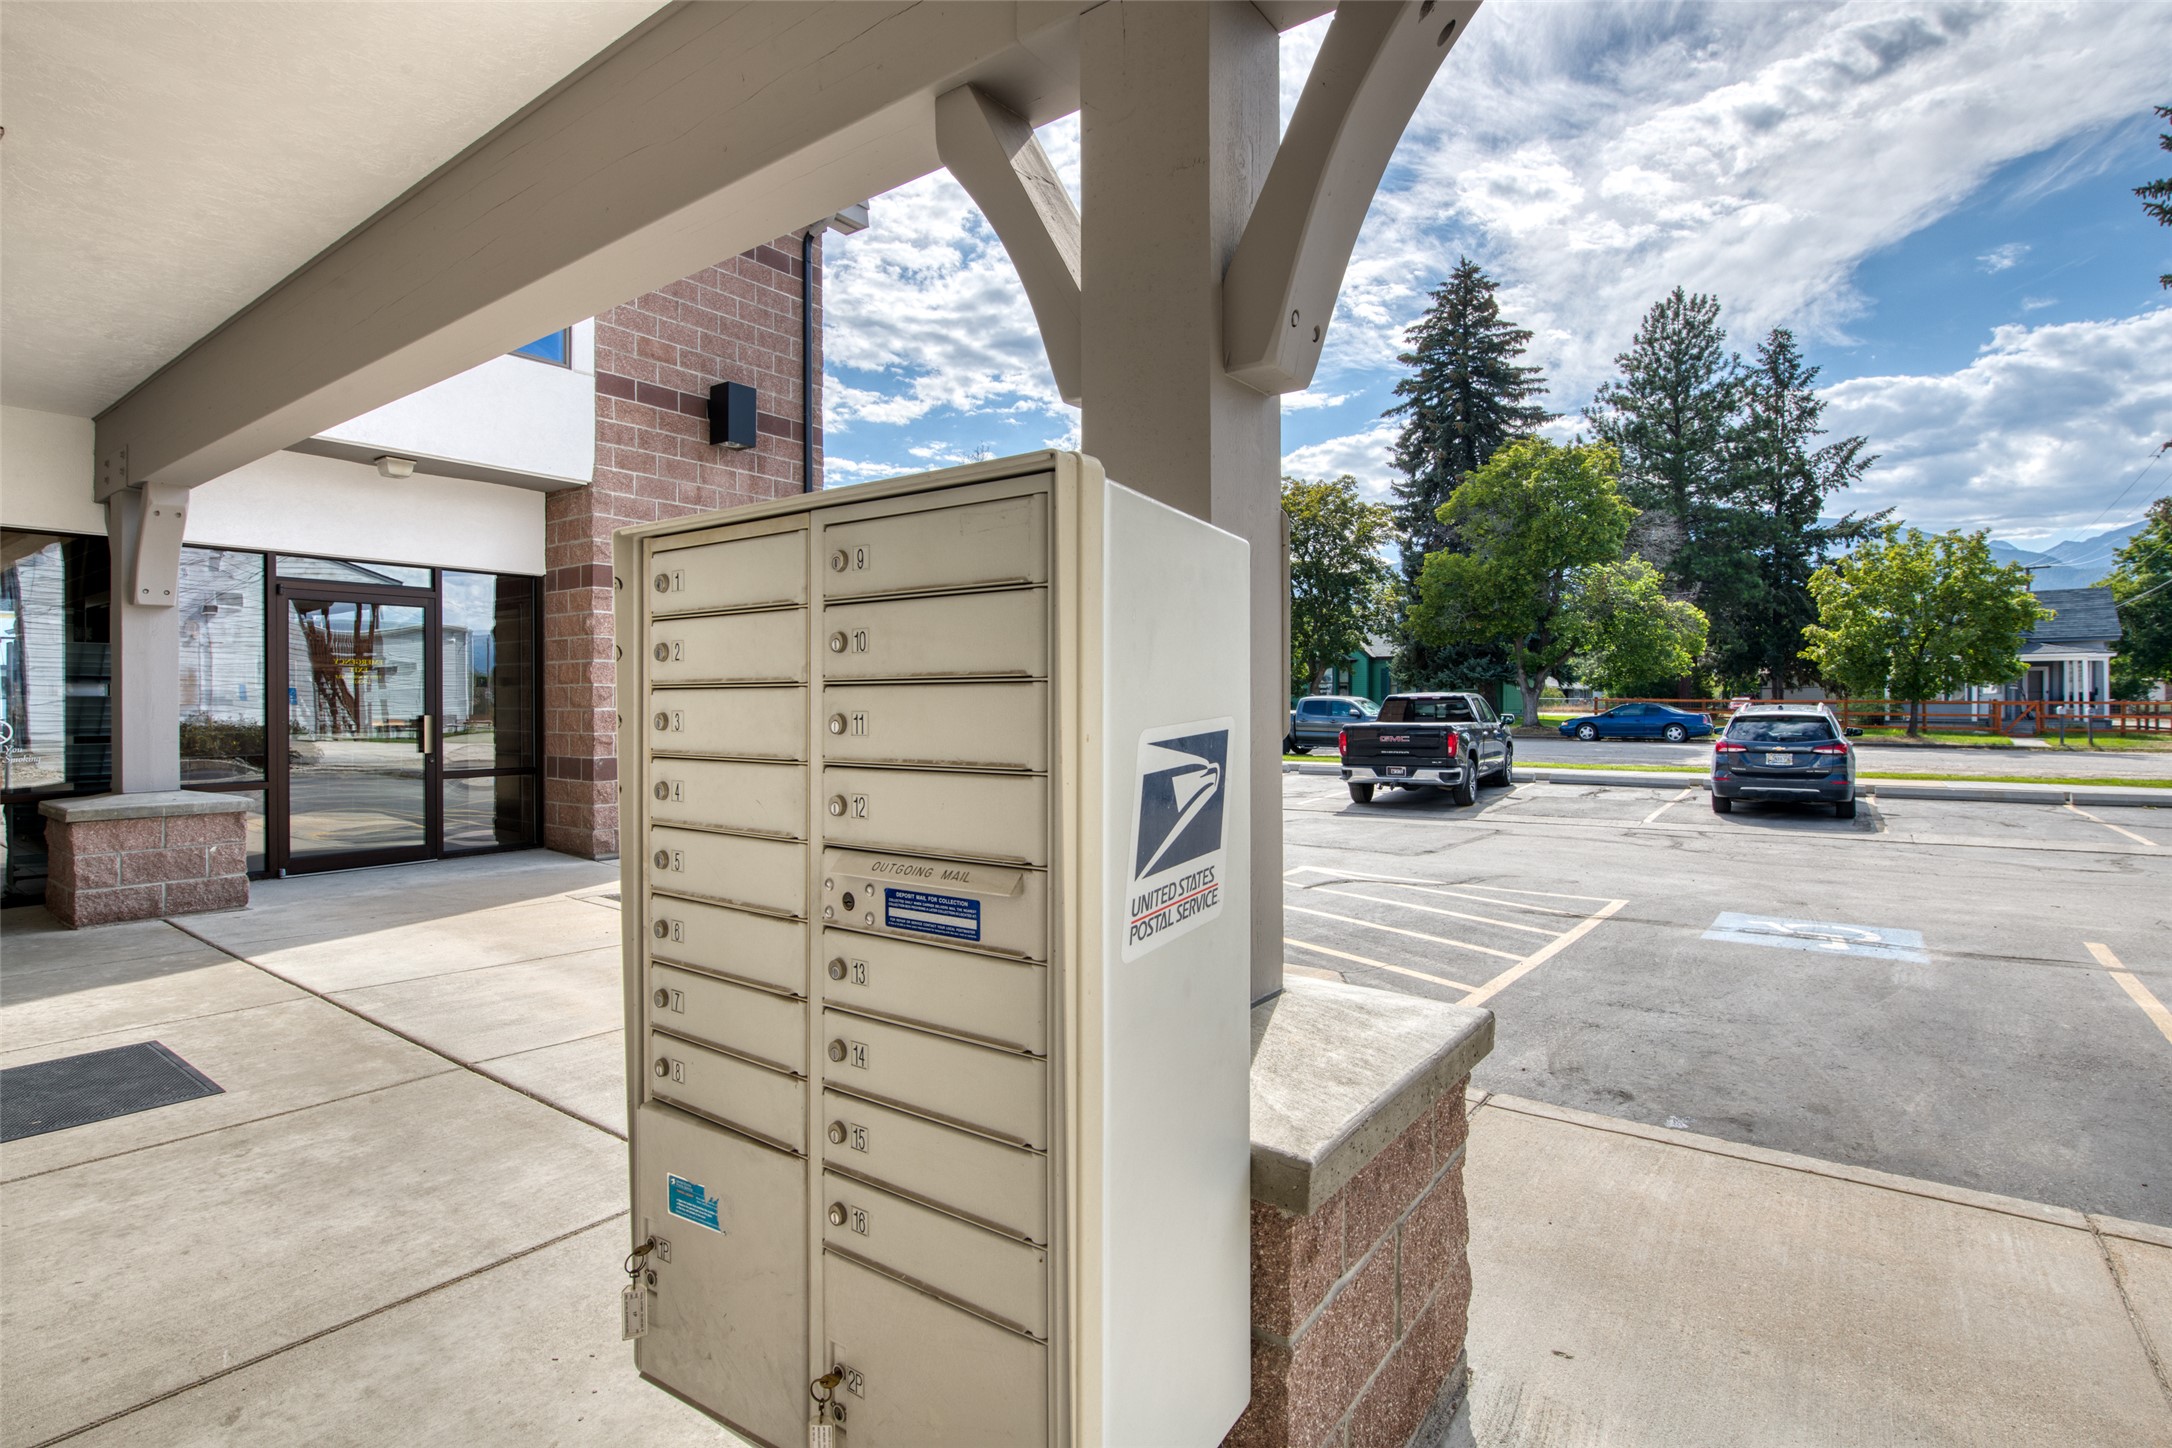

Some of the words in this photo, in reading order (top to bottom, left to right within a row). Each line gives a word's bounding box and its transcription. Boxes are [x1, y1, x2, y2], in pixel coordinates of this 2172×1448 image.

[856, 549, 864, 569] 9
[854, 630, 866, 651] 10
[674, 643, 680, 660] 2
[674, 713, 680, 730] 3
[854, 712, 865, 734] 11
[4, 745, 23, 754] You
[674, 783, 680, 800] 4
[853, 795, 866, 817] 12
[674, 853, 680, 870] 5
[872, 862, 934, 877] OUTGOING
[941, 869, 970, 883] MAIL
[1131, 881, 1177, 917] UNITED
[1179, 865, 1215, 897] STATES
[939, 898, 968, 907] COLLECTION
[1129, 911, 1174, 946] POSTAL
[1176, 887, 1218, 923] SERVICE
[674, 924, 680, 941] 6
[853, 962, 866, 984] 13
[674, 993, 680, 1011] 7
[853, 1044, 866, 1066] 14
[674, 1063, 681, 1081] 8
[853, 1127, 866, 1148] 15
[853, 1210, 866, 1232] 16
[658, 1241, 670, 1260] 1P
[848, 1369, 862, 1394] 2P
